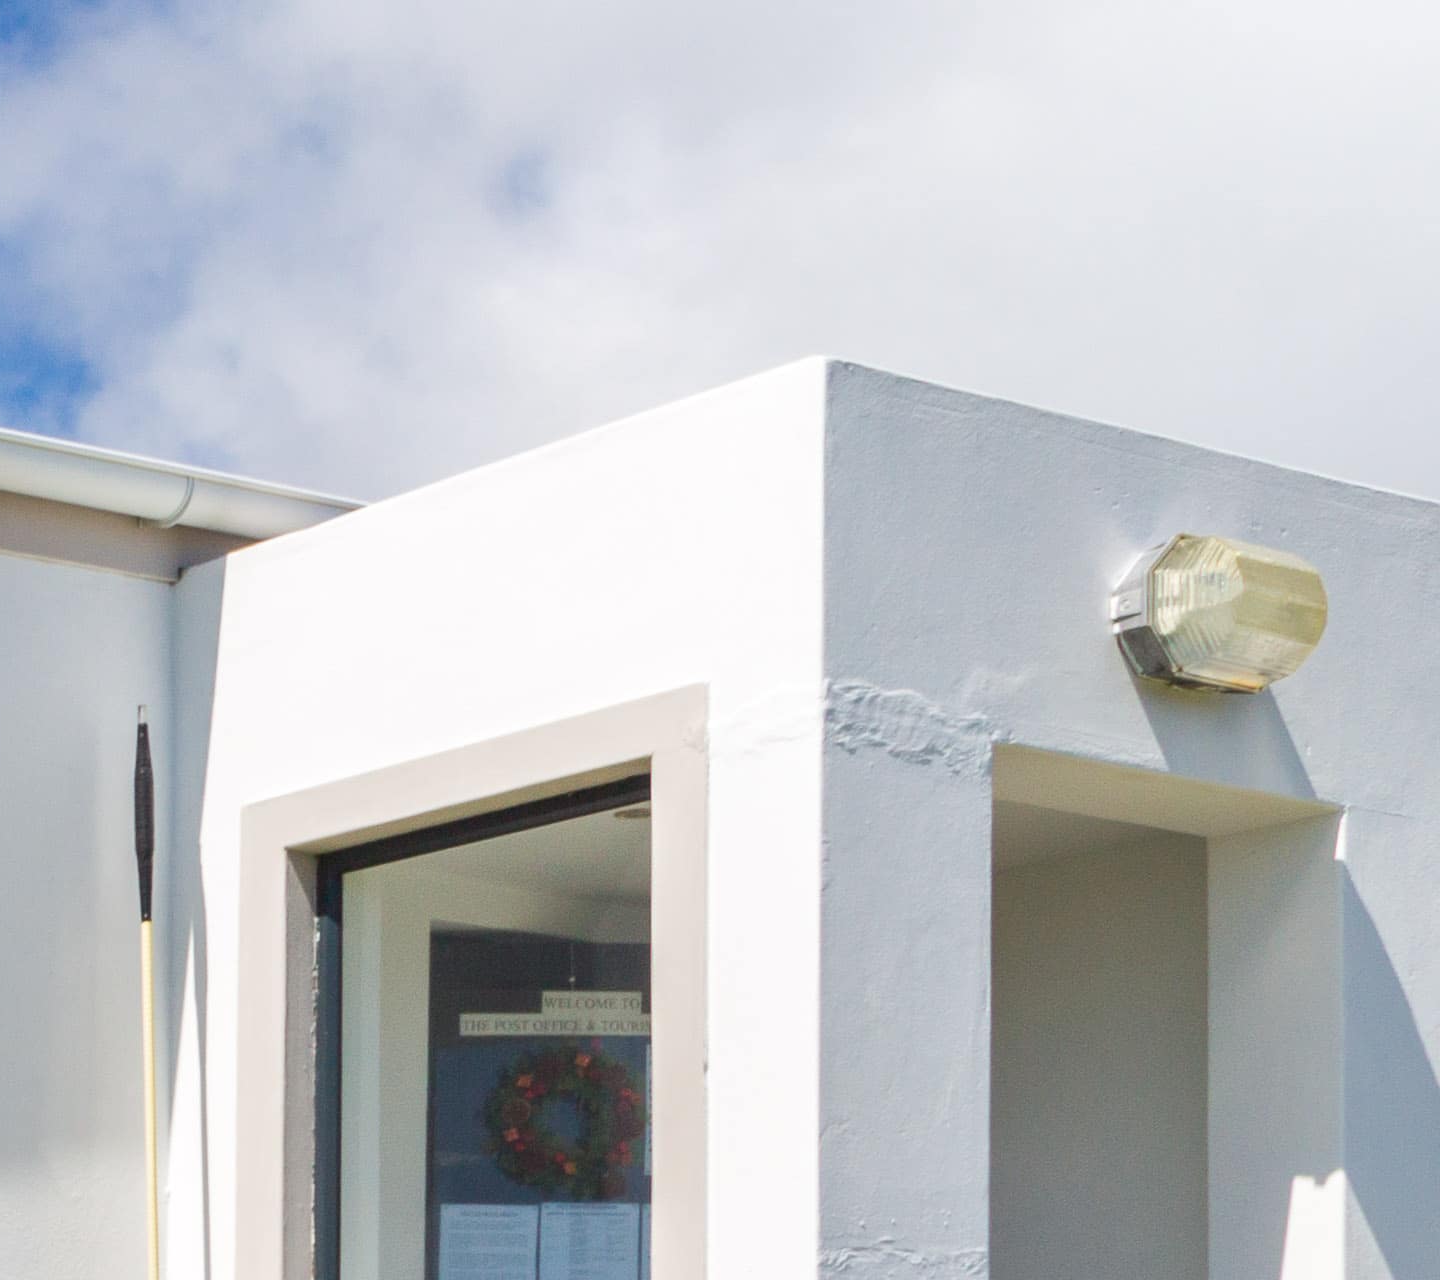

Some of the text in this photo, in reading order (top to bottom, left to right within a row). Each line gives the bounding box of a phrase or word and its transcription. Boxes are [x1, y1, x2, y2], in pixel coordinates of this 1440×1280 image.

[543, 997, 641, 1010] WELCOME TO
[495, 1020, 529, 1032] POST
